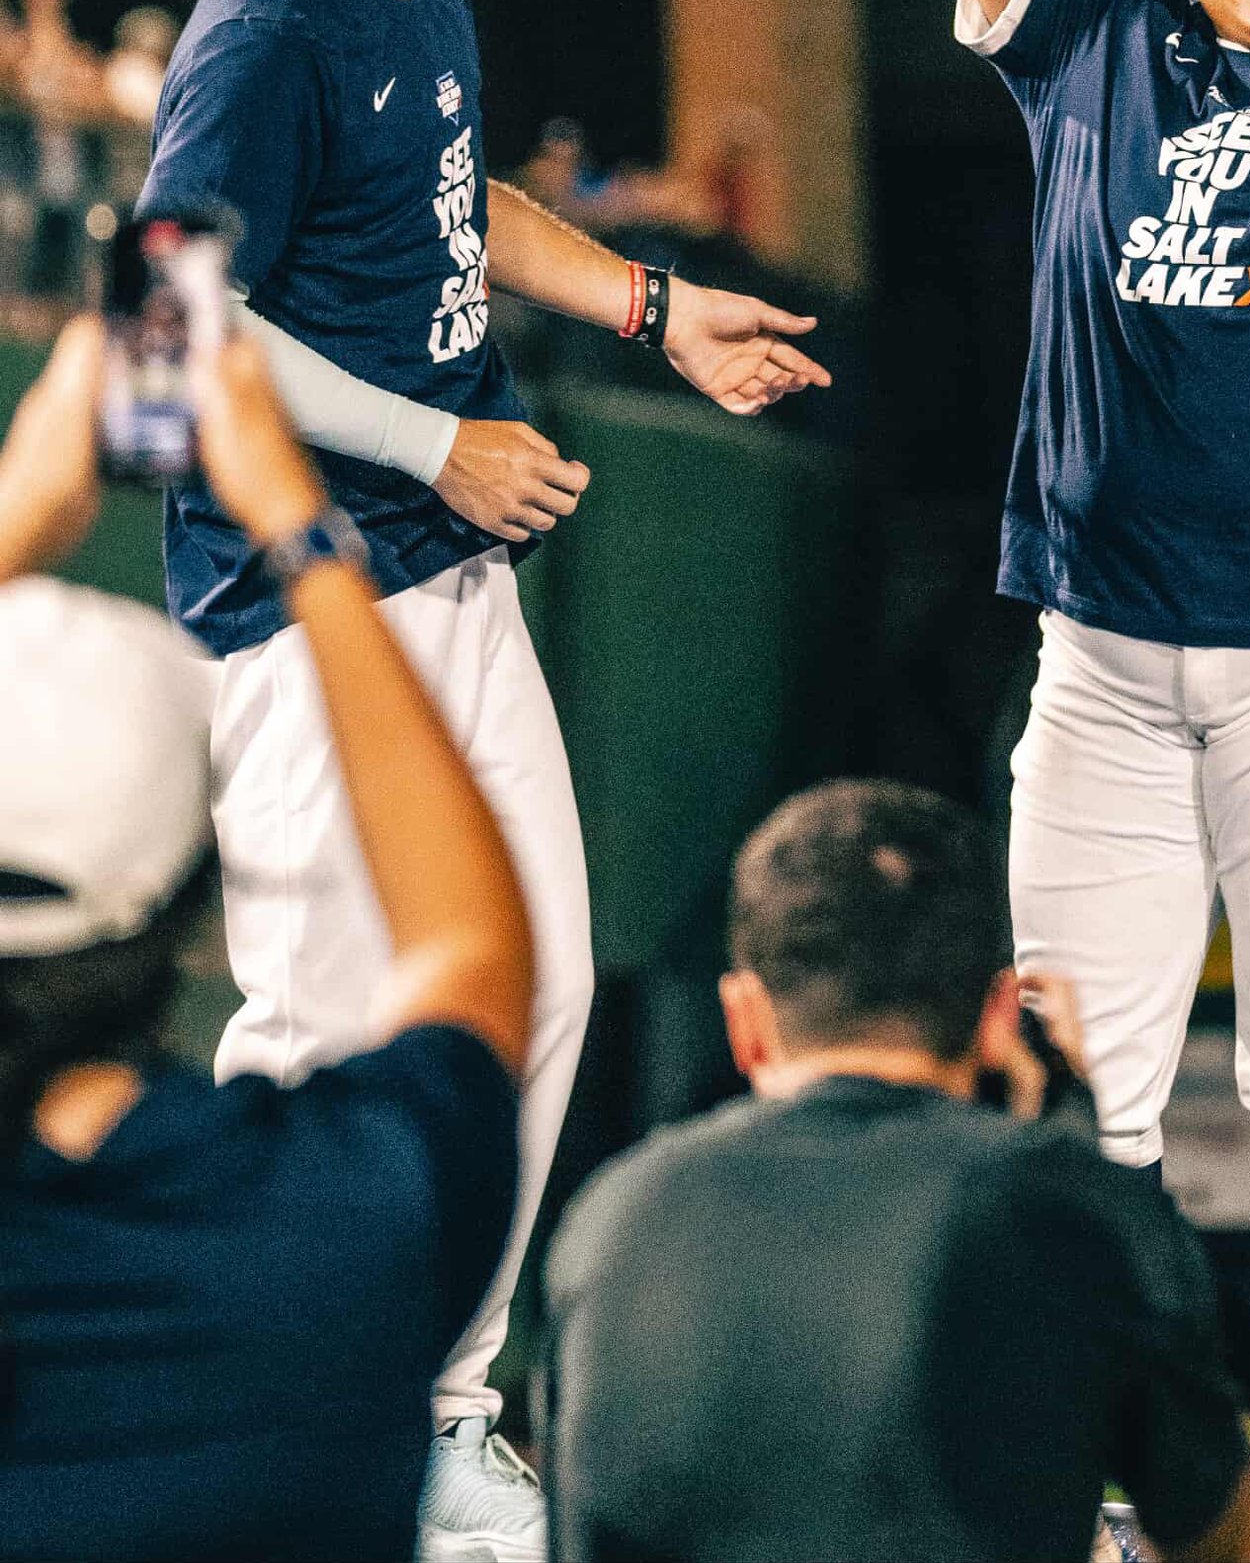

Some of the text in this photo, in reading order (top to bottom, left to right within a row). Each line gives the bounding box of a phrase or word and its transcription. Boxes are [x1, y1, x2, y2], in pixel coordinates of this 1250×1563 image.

[1163, 179, 1221, 227] IN
[1121, 215, 1247, 265] SALT
[1115, 258, 1246, 307] LAKE
[428, 301, 489, 364] LAK
